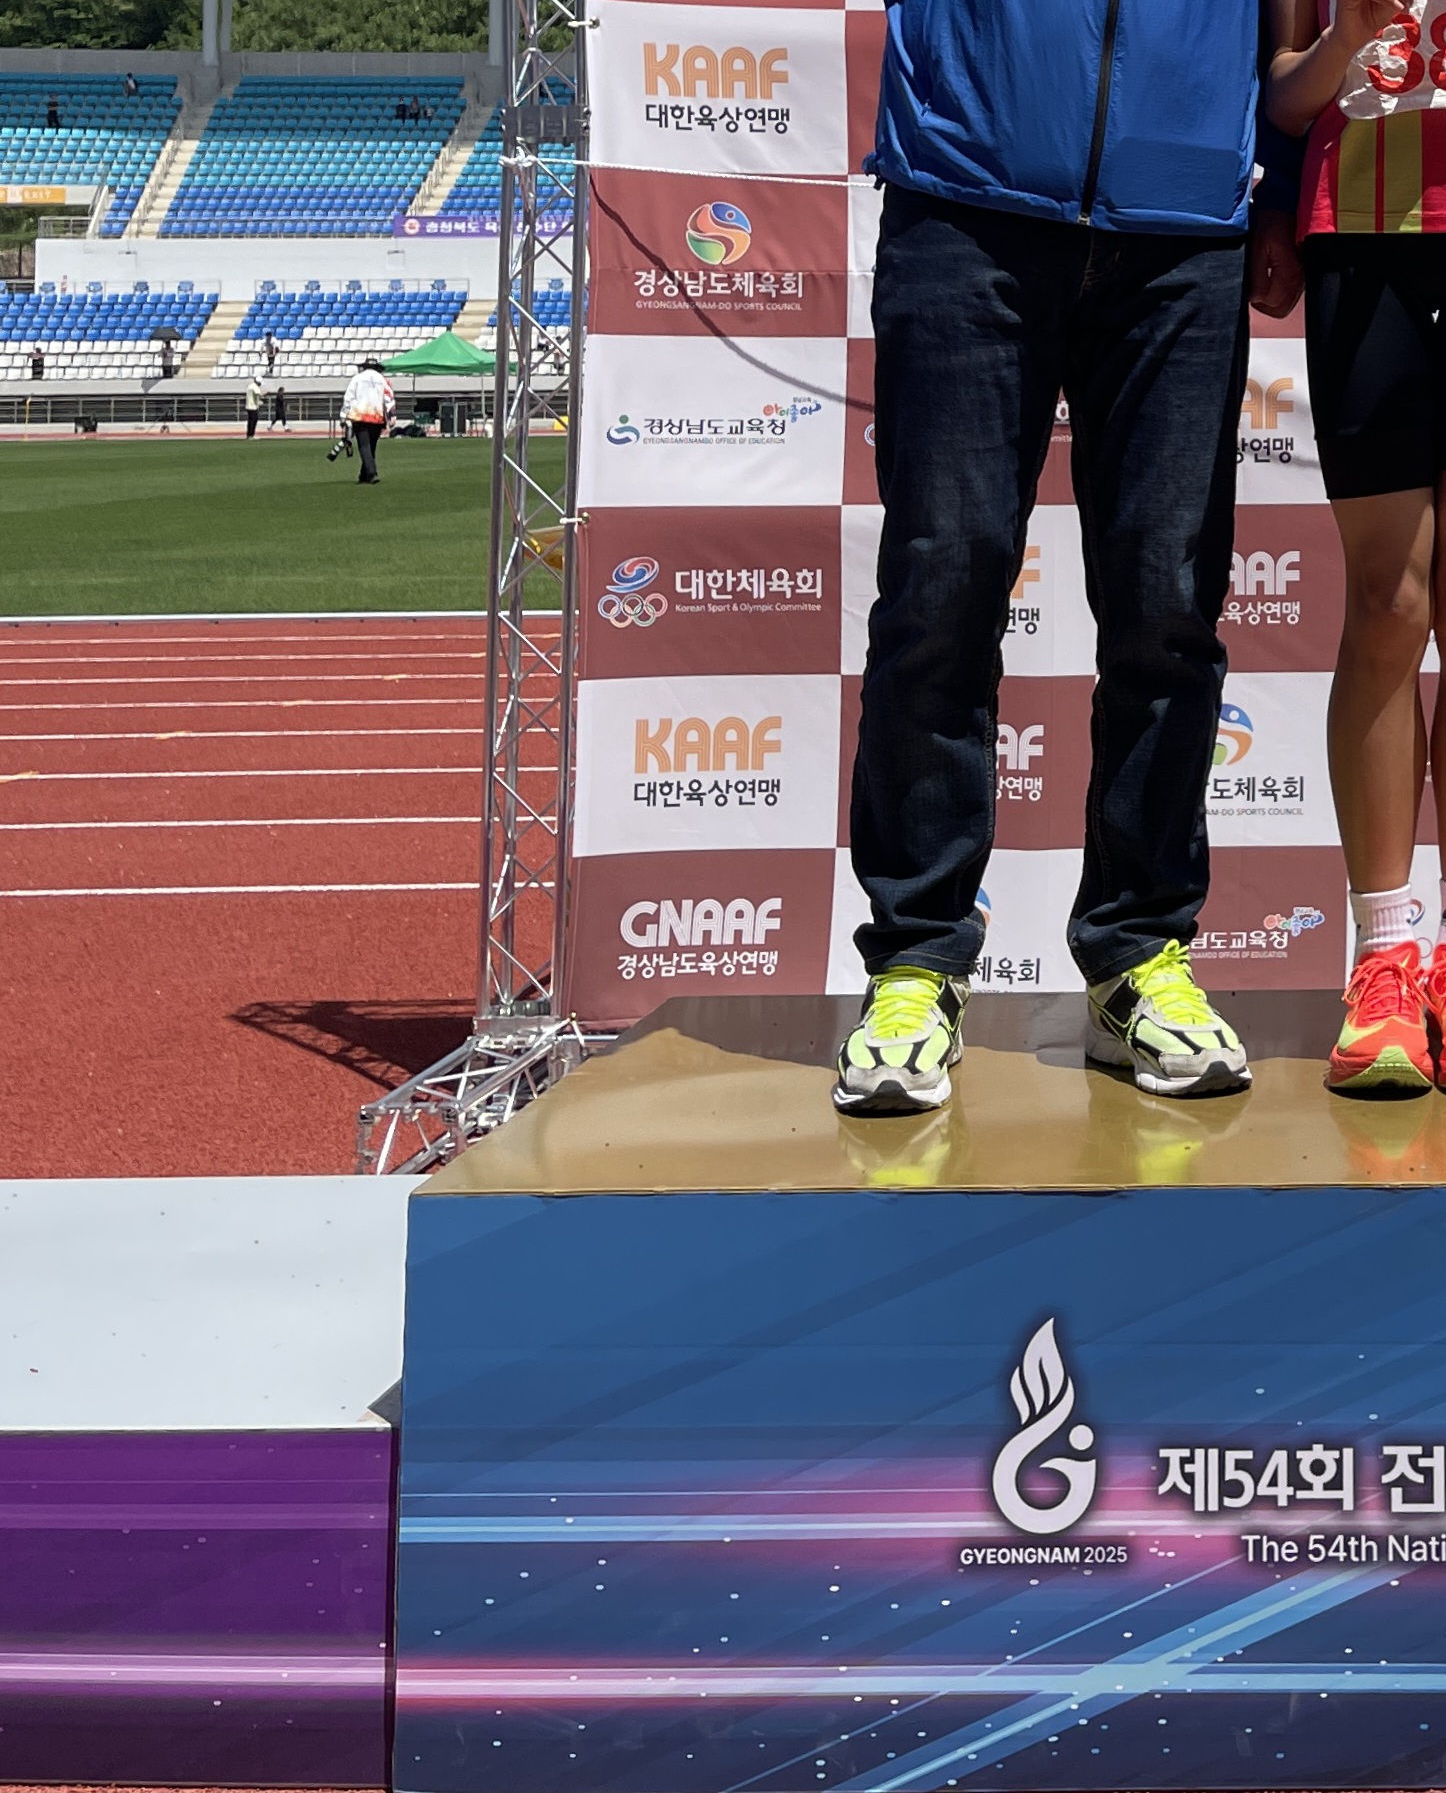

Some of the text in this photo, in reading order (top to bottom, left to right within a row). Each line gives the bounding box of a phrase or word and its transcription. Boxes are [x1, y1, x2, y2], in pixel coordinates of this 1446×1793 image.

[644, 43, 789, 99] KAAF
[646, 104, 789, 134] 대한육상연맹
[634, 269, 803, 298] 경상남도체육회
[636, 300, 732, 310] GYEONGSANGNAM-DO
[734, 303, 764, 311] SPORTS
[645, 419, 785, 435] 경상남도교육청
[676, 568, 822, 599] 대한체육회
[1230, 551, 1300, 595] AAF
[676, 603, 821, 613] Korean Sport & Olympic Committee
[1222, 601, 1300, 625] 육상연맹
[635, 716, 782, 773] KAAF
[634, 779, 780, 807] 대한육상연맹
[1210, 776, 1303, 802] 도체육회
[621, 898, 782, 947] GNAAF
[1191, 930, 1289, 949] 남도교육청
[618, 951, 778, 979] 경상남도육상연맹
[1157, 1443, 1355, 1512] 제54회
[961, 1547, 1127, 1564] GYEONGNAM 2025
[1241, 1534, 1301, 1563] The
[1304, 1535, 1380, 1564] 54th
